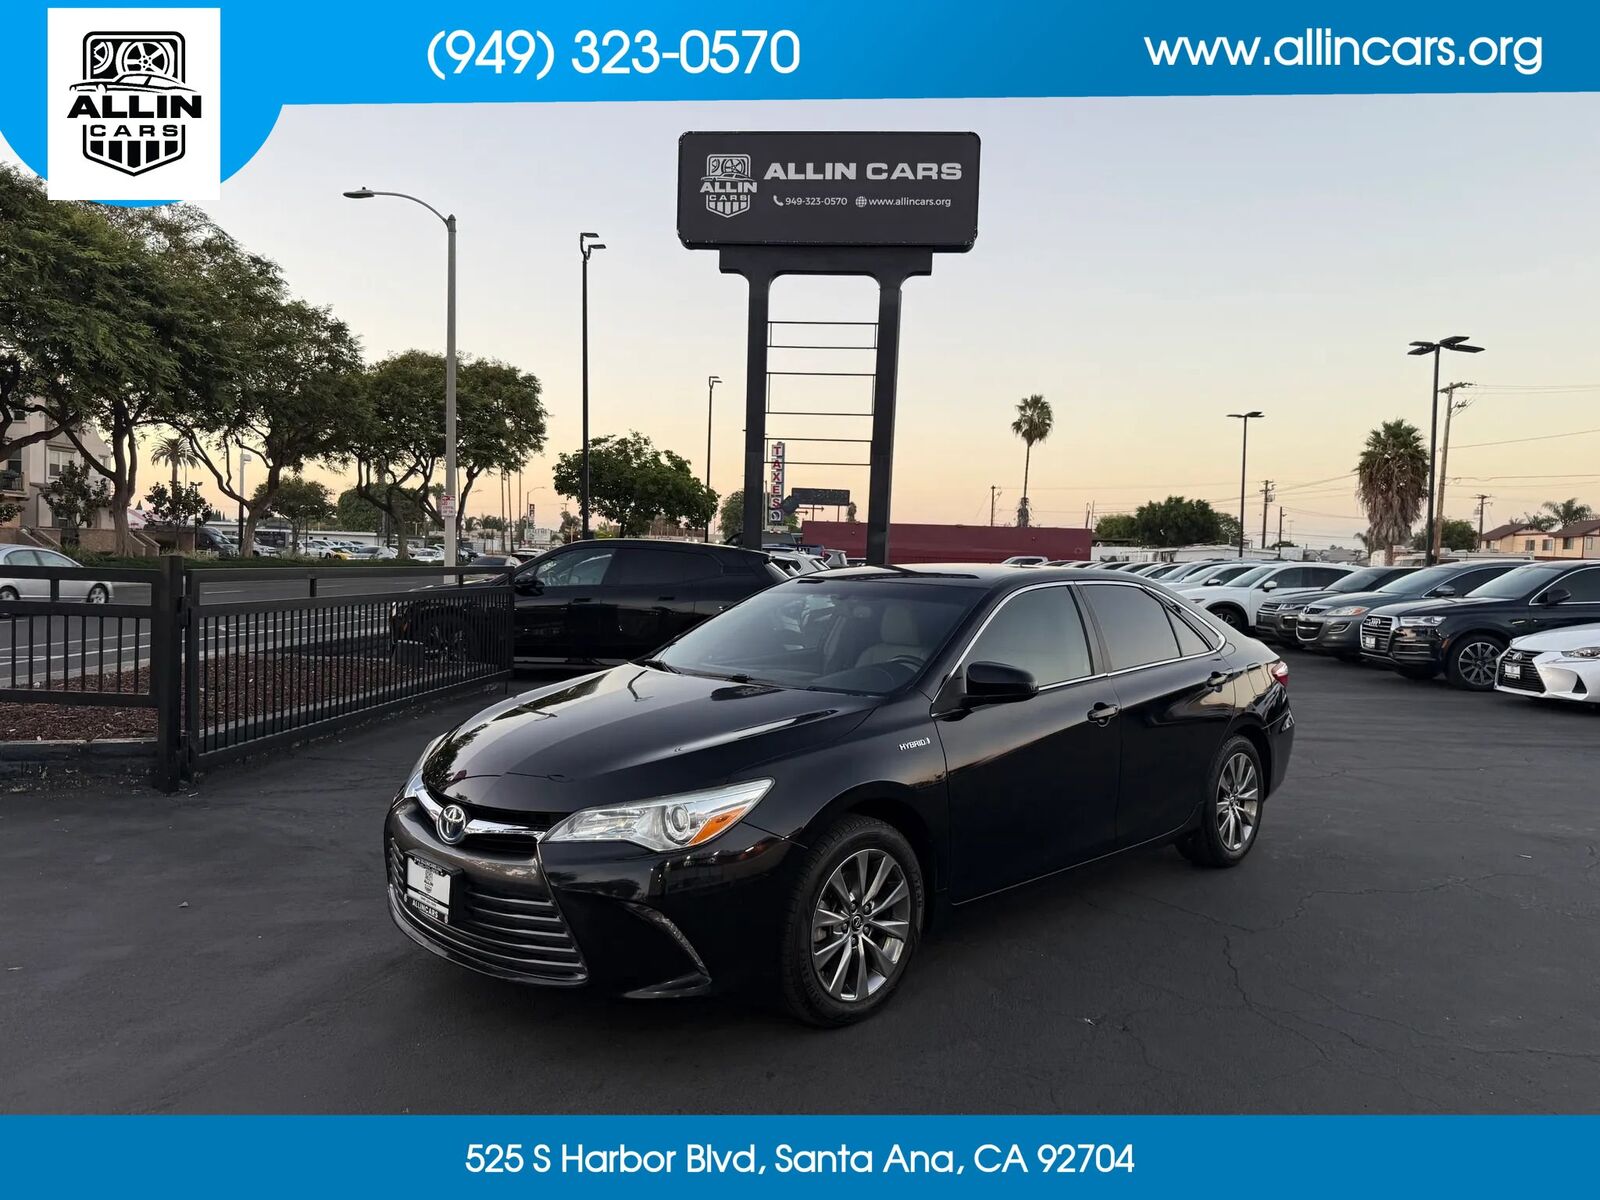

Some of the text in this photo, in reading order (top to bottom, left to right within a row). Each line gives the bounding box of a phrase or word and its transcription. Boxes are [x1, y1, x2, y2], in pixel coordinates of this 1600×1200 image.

[763, 162, 962, 180] ALLIN CARS
[699, 181, 758, 194] ALLIN
[709, 194, 748, 202] CARS
[785, 195, 848, 206] 949-323-0570
[868, 195, 952, 209] www.allincars.org
[772, 446, 782, 508] TAXES
[899, 739, 926, 751] HYBRID
